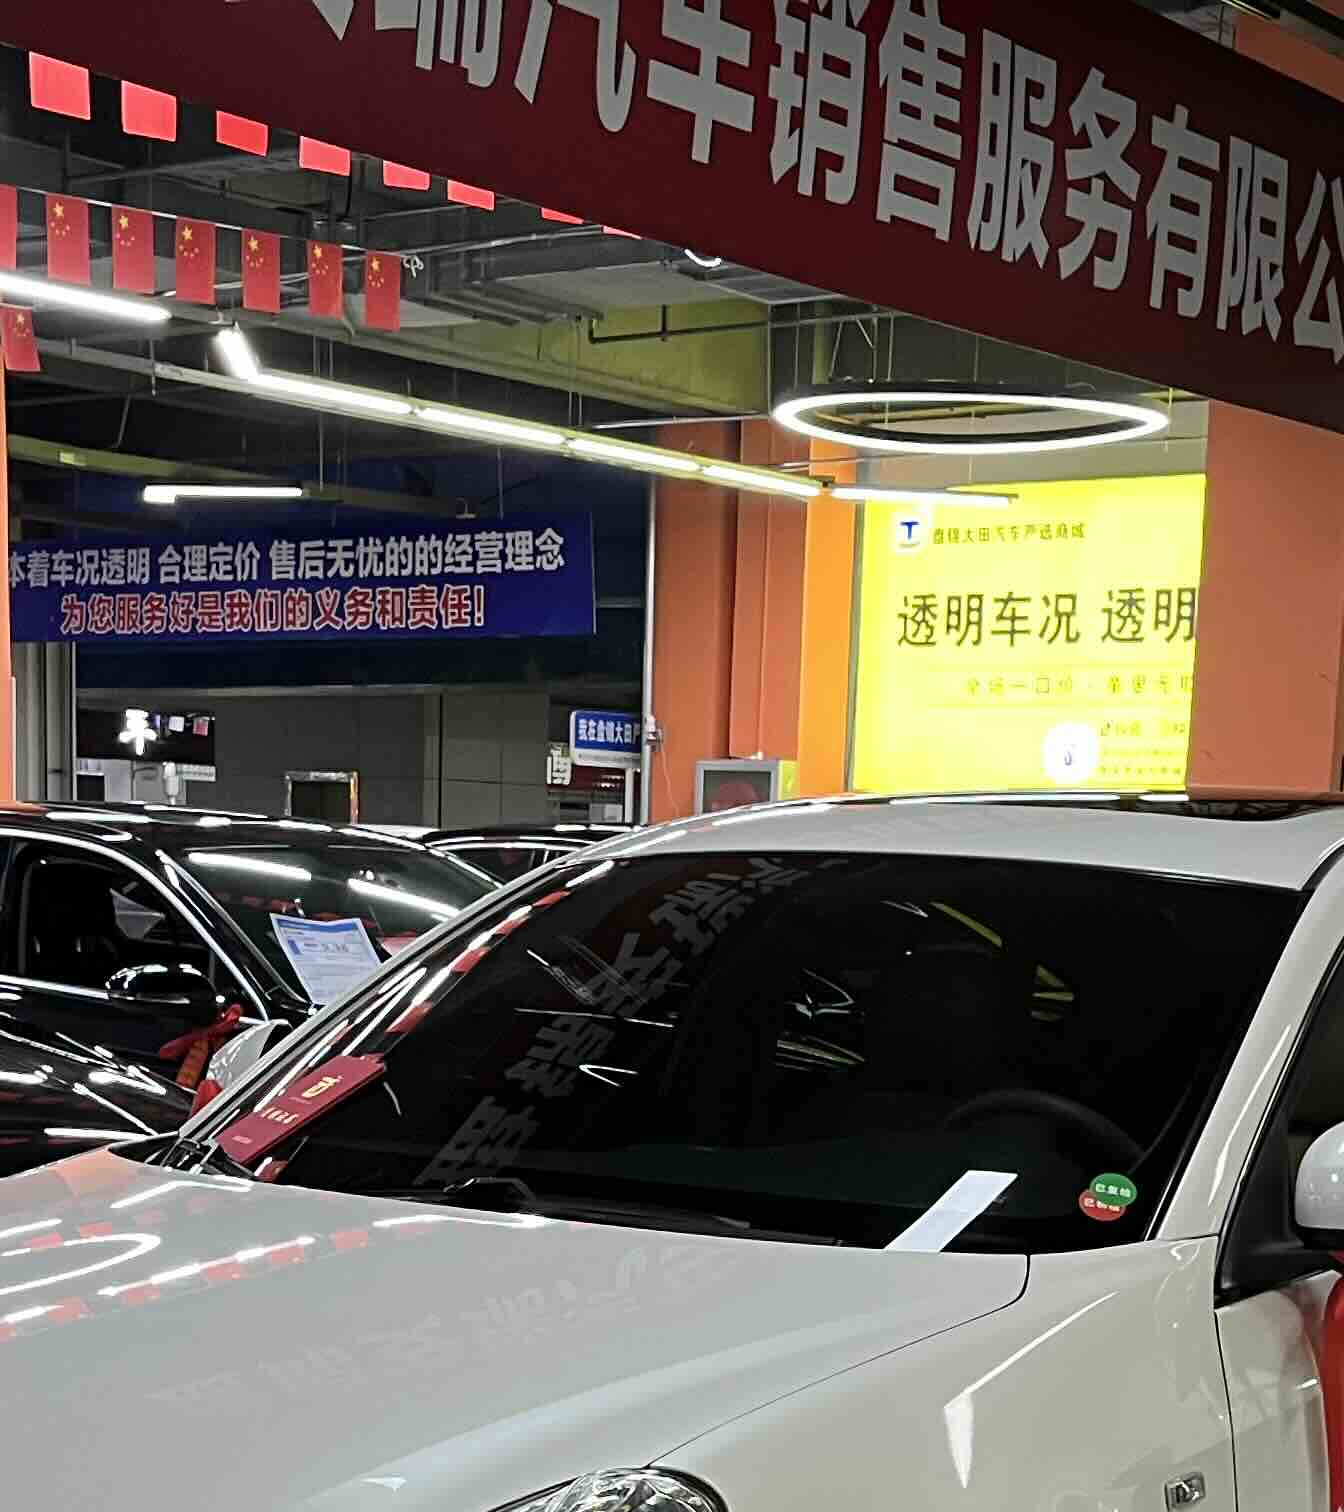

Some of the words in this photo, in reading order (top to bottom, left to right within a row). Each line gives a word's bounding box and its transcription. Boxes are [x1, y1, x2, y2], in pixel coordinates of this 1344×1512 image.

[158, 541, 260, 585] 合理定价
[269, 527, 565, 581] 售后无忧的的经营理念
[61, 584, 485, 635] 为您服务好是我们的义务和责任!
[897, 592, 1081, 647] 透明车况
[1101, 586, 1198, 644] 透明
